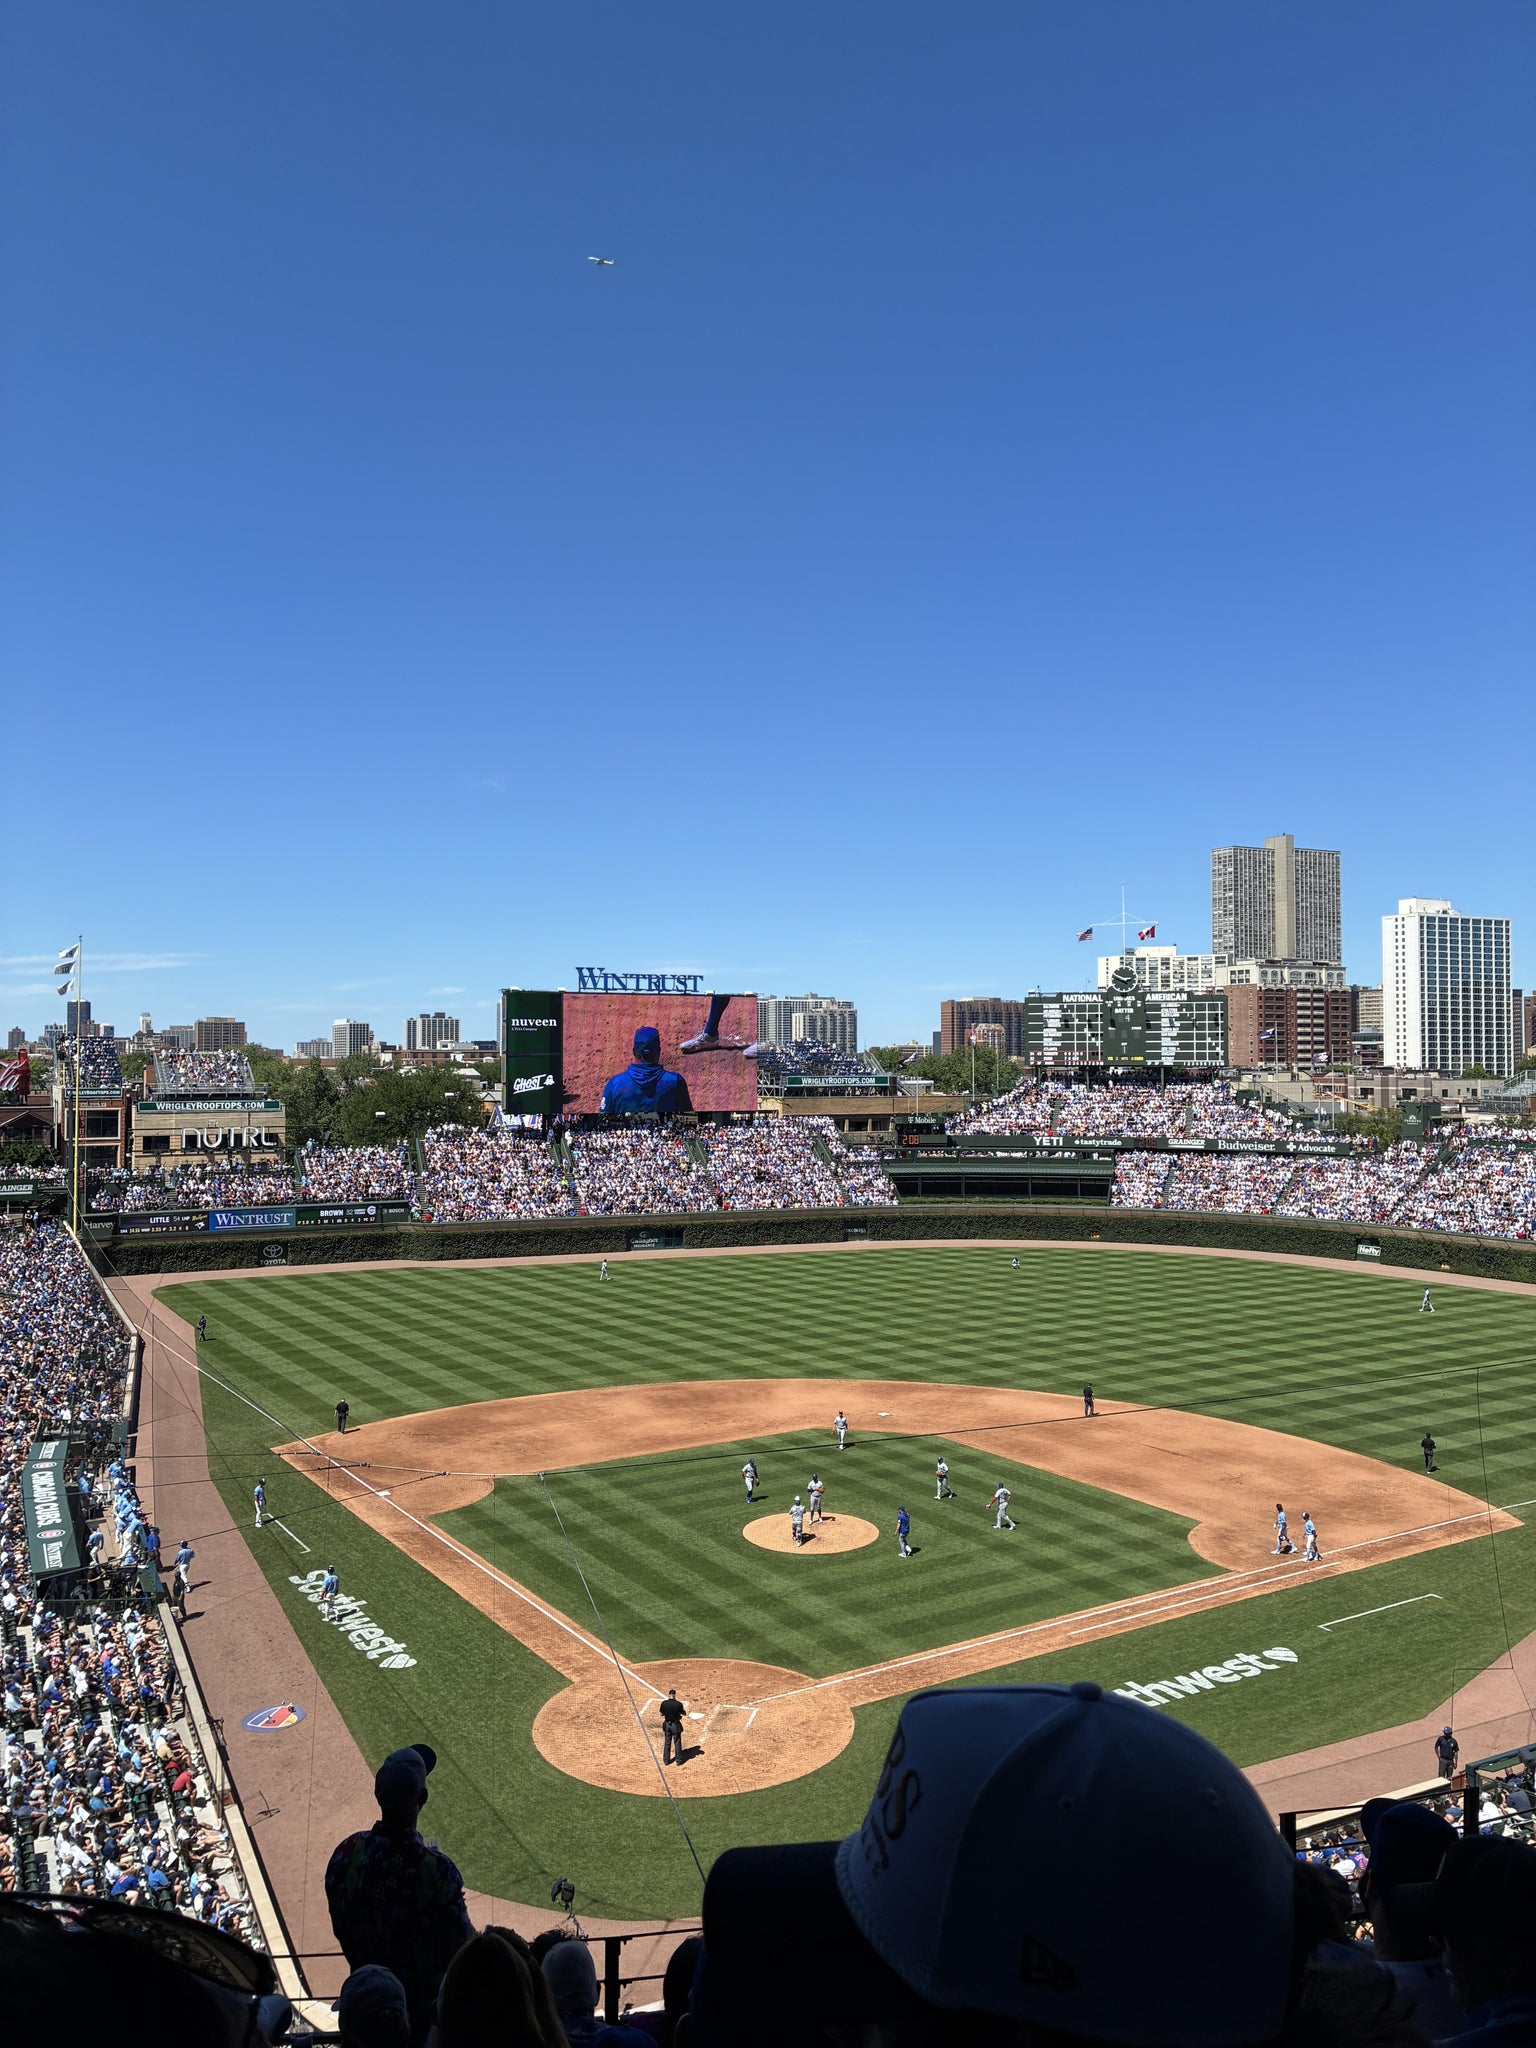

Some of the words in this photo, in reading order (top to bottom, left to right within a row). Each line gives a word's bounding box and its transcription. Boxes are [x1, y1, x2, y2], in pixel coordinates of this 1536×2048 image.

[576, 967, 704, 992] WINTRUST
[1062, 994, 1103, 1002] NATIONAL
[1145, 993, 1187, 1001] AMERICAN
[511, 1018, 557, 1026] nuveen
[513, 1074, 547, 1093] GHOST
[156, 1102, 264, 1110] WRIGLEYROOFTOPS.COM
[1033, 1137, 1063, 1146] YETI
[1218, 1140, 1273, 1150] Budweiser
[1298, 1144, 1336, 1153] Advocate
[216, 1213, 289, 1225] WINTRUST
[1359, 1246, 1380, 1256] Hefty
[31, 1471, 58, 1503] CHICAGO
